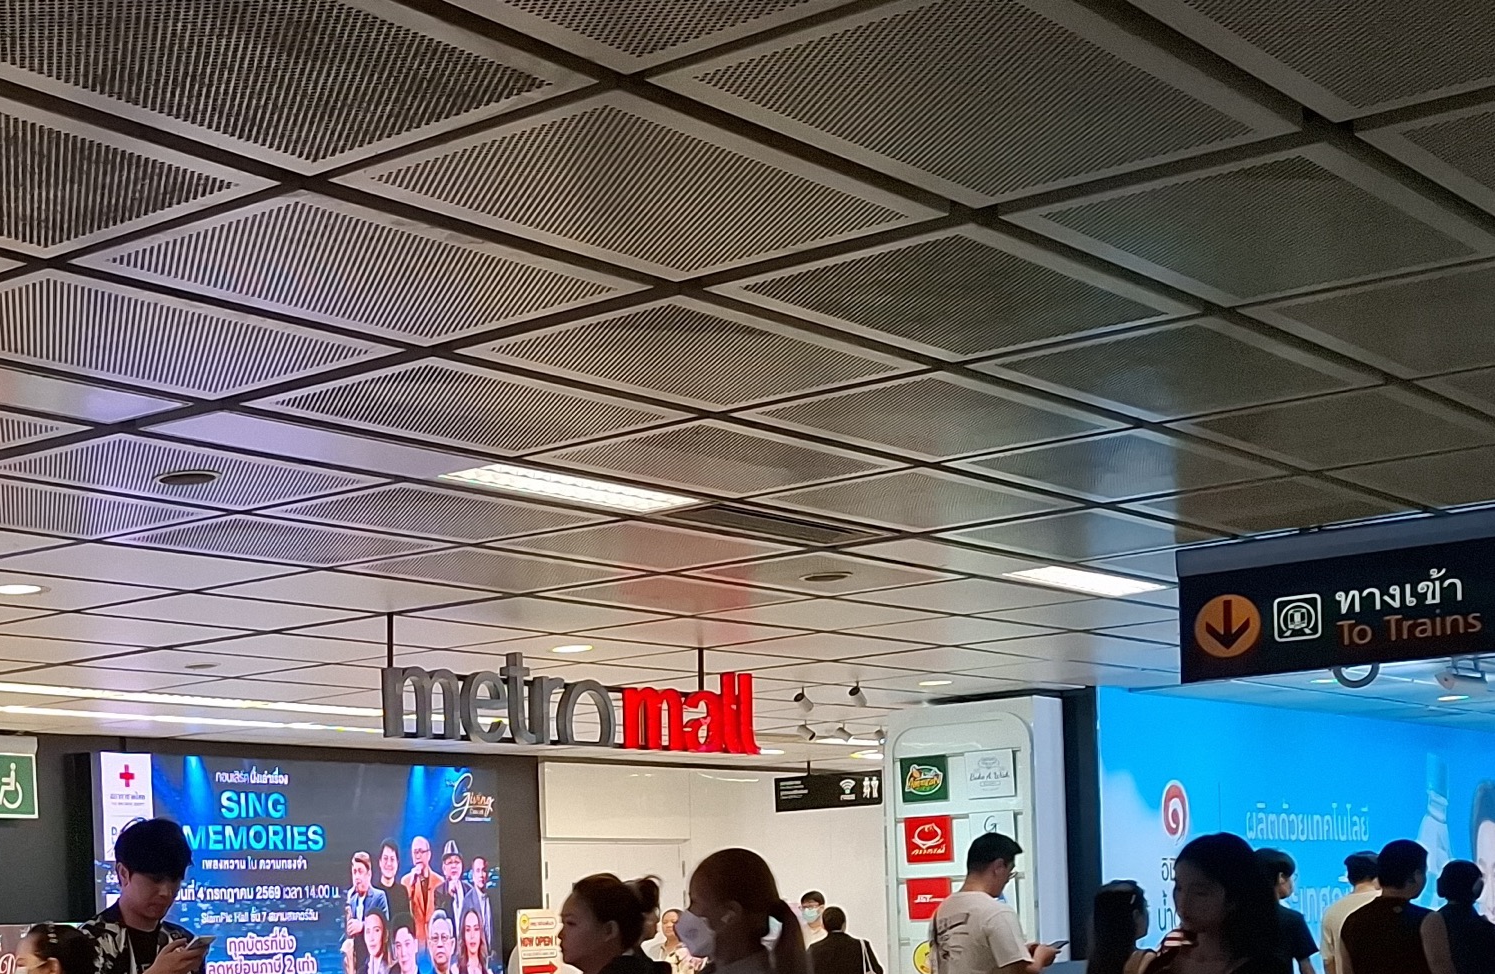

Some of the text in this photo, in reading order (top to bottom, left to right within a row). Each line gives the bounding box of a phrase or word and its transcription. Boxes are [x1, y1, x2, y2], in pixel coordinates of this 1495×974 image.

[1335, 567, 1463, 615] ทางเข้า
[1336, 608, 1483, 646] To Trains
[220, 790, 286, 819] SING
[182, 825, 324, 850] MEMORIES
[1246, 802, 1370, 842] ผลิตด้วยเทคโนโลยี
[197, 886, 205, 900] 4
[256, 885, 281, 900] 2569
[282, 886, 303, 899] เวลา
[227, 926, 297, 960] ทุกบัตรที่นั่ง
